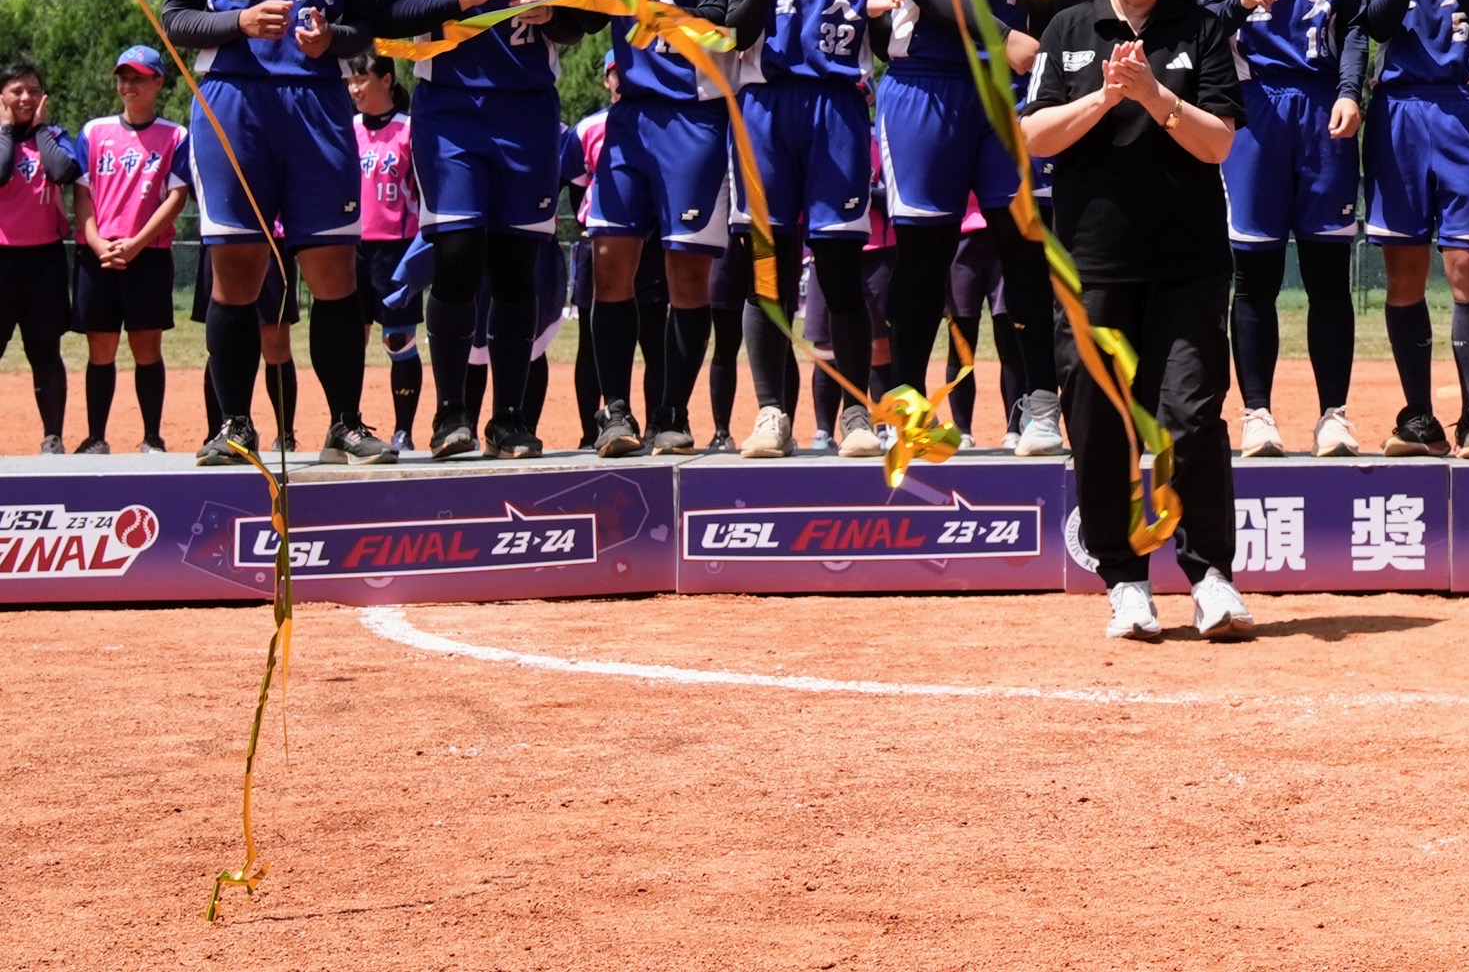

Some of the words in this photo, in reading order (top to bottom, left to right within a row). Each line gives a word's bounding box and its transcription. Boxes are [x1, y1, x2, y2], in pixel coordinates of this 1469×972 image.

[819, 22, 856, 55] 32
[97, 150, 163, 176] 北市大
[376, 182, 398, 201] 19
[341, 532, 480, 568] FINAL
[701, 522, 780, 549] USL
[790, 518, 927, 551] FINAL
